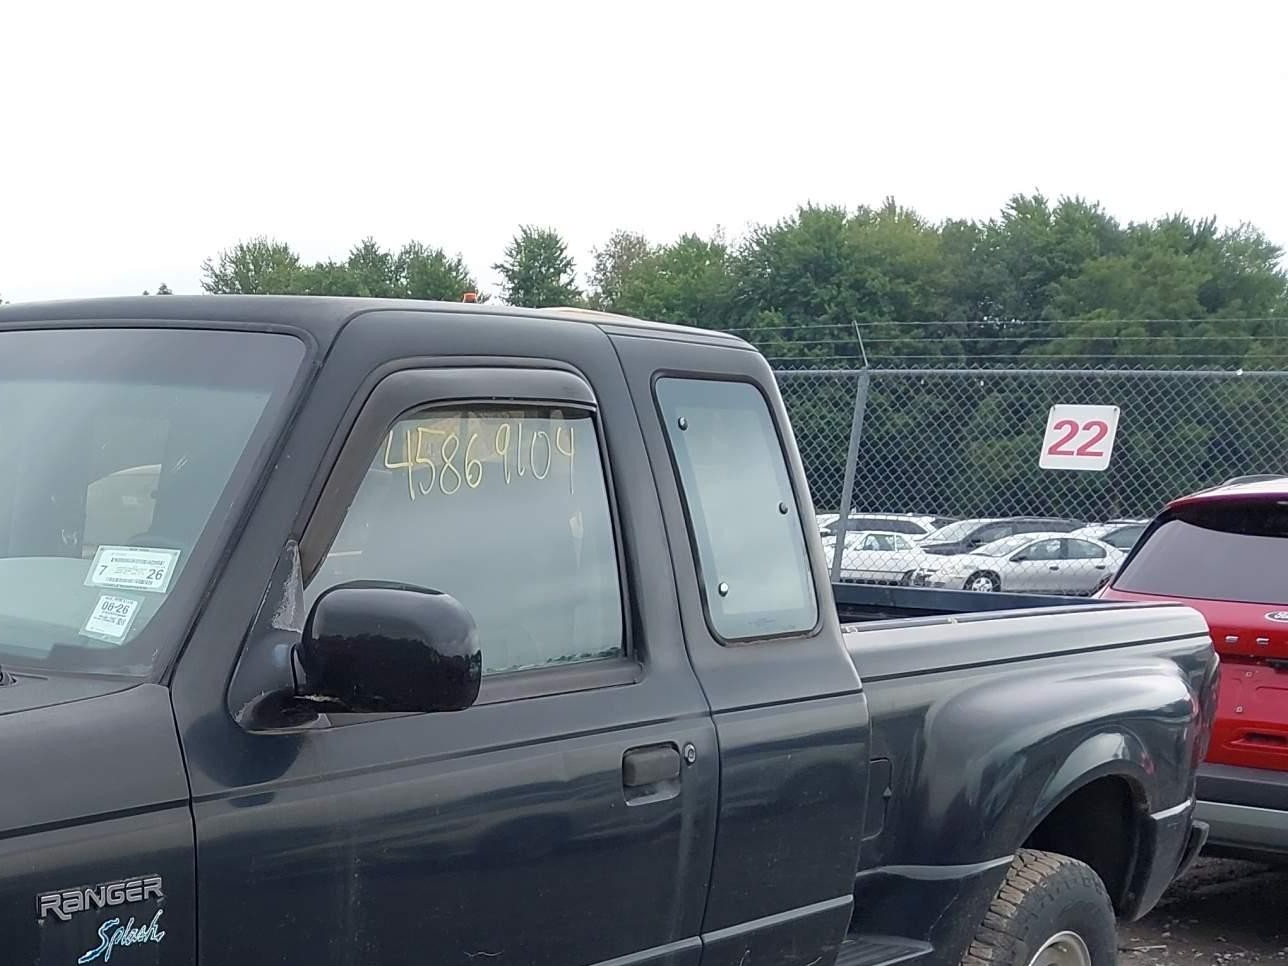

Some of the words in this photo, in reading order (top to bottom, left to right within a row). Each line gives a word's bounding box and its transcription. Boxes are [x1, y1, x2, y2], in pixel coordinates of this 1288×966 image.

[1047, 418, 1109, 457] 22
[384, 423, 575, 501] 45869104
[98, 564, 108, 575] 7
[146, 568, 165, 580] 26
[39, 876, 164, 921] RANGER
[77, 908, 167, 965] Splash
